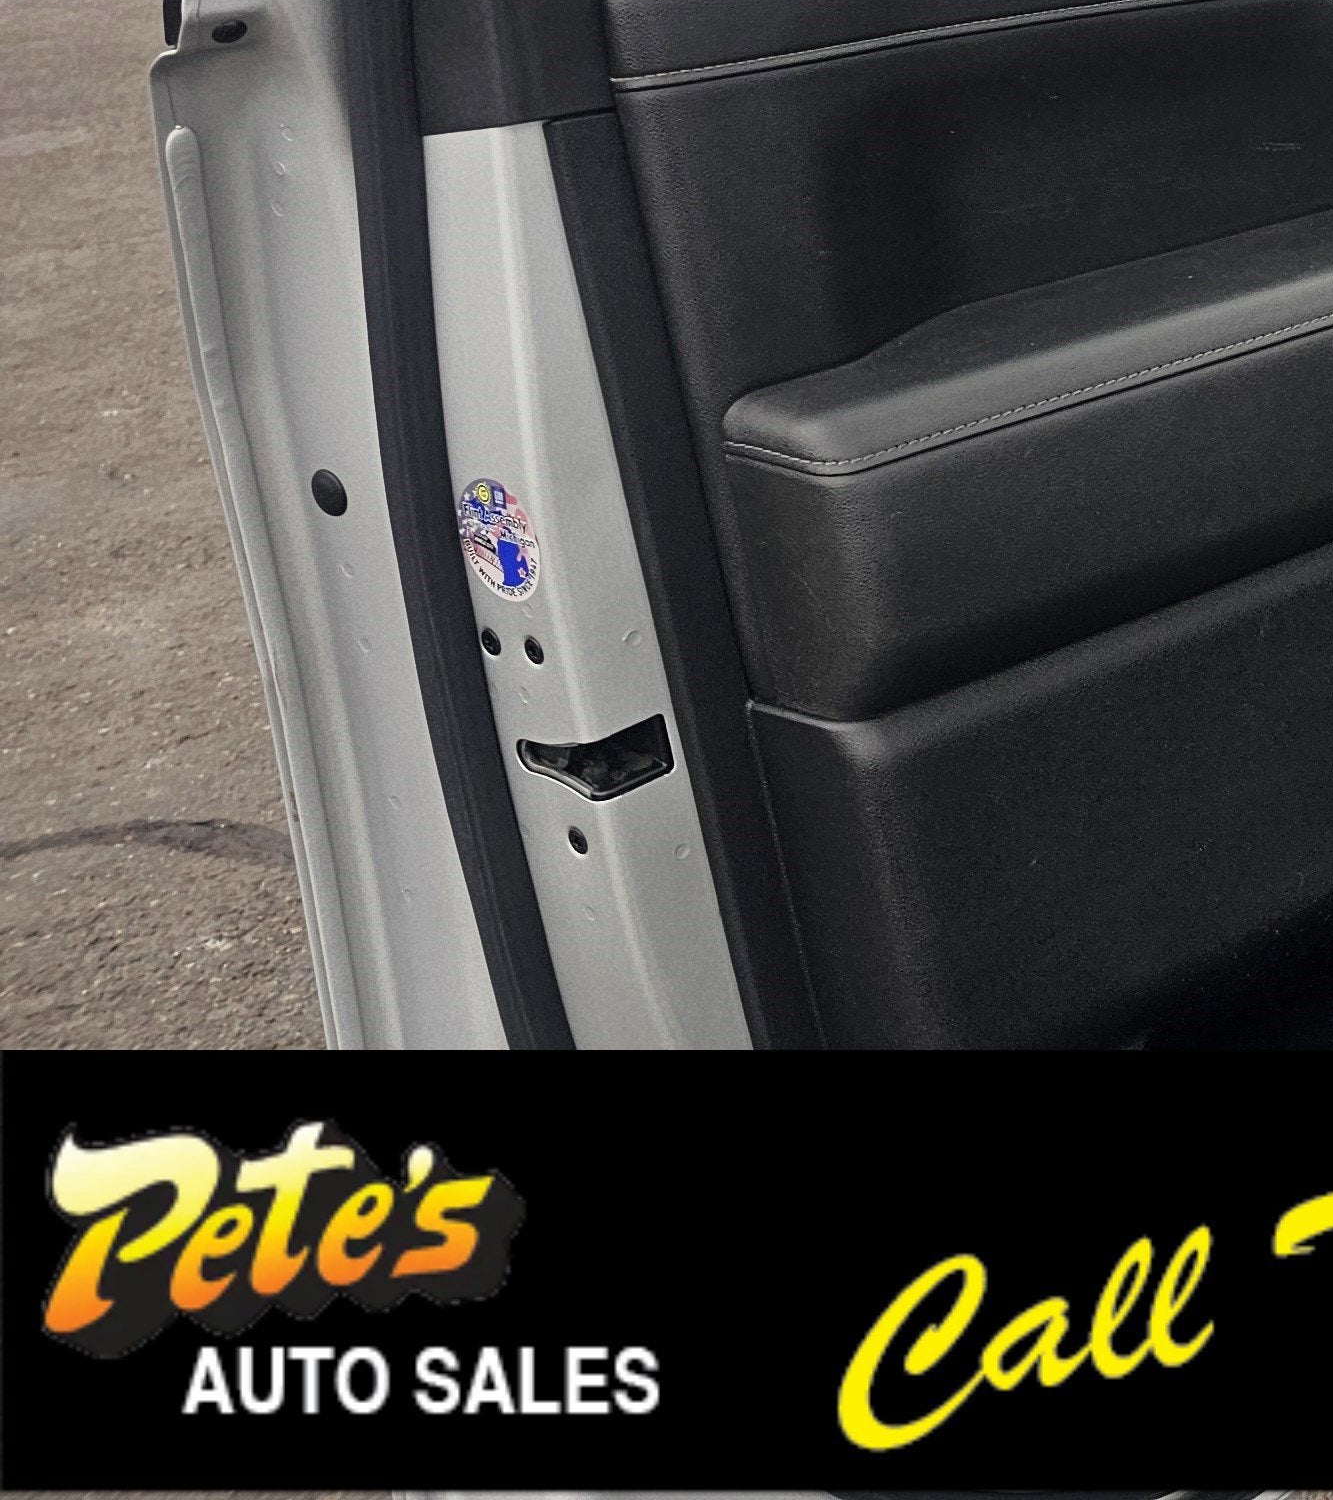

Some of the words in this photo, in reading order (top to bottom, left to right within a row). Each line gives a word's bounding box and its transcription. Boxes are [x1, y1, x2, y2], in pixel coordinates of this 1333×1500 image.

[463, 503, 485, 521] Flint
[485, 509, 527, 534] Assembly
[500, 529, 536, 549] Michigan
[497, 582, 518, 597] PRIDE
